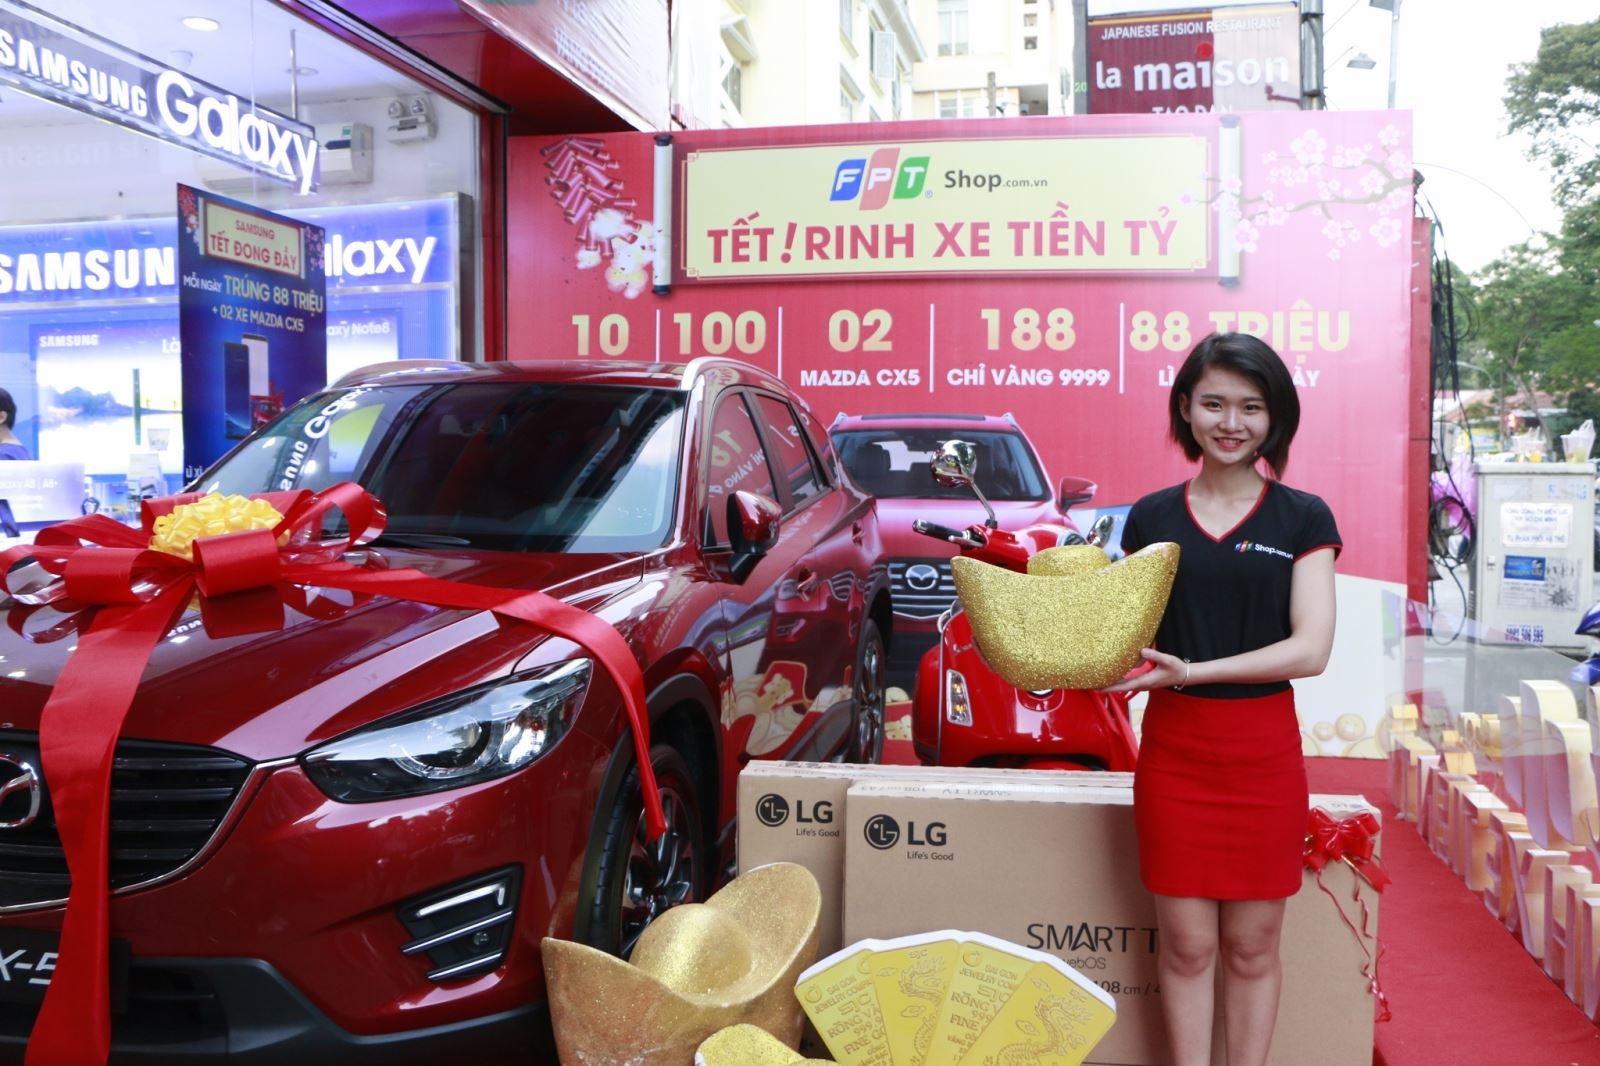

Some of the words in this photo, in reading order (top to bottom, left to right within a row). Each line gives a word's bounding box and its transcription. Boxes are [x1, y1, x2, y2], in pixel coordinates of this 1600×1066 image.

[1101, 25, 1159, 40] JAPANESE
[1162, 22, 1204, 36] FUSION
[1206, 16, 1282, 34] RESTAURANT
[1096, 60, 1122, 90] la
[1133, 50, 1289, 92] maison
[0, 29, 148, 118] SAMSUNG
[156, 70, 318, 196] Galaxy
[832, 162, 928, 196] FPT
[210, 230, 230, 254] TẾT
[234, 219, 276, 240] SAMSUNG
[805, 222, 914, 260] RINH
[932, 222, 990, 258] XE
[1007, 200, 1106, 257] TIỀN
[1123, 205, 1178, 256] TỶ
[0, 246, 176, 294] SAMSUN
[325, 234, 438, 284] laxy
[224, 273, 271, 302] TRÚNG
[273, 286, 290, 306] 88
[292, 288, 324, 318] TRIỆU
[220, 303, 233, 319] 02
[235, 307, 249, 323] XE
[251, 310, 284, 329] MAZDA
[285, 317, 305, 333] CX5
[351, 321, 391, 335] Note8
[673, 310, 767, 354] 100
[828, 309, 893, 352] 02
[980, 307, 1077, 351] 188
[1129, 310, 1193, 352] 88
[39, 334, 99, 348] SAMSUNG
[572, 313, 630, 356] 10
[800, 369, 871, 386] MAZDA
[875, 369, 921, 386] CX5
[946, 363, 985, 386] CHỈ
[990, 363, 1054, 386] VÀNG
[1058, 368, 1111, 386] 9999
[796, 799, 833, 824] LG
[796, 828, 817, 836] Life's
[818, 829, 840, 837] Good
[907, 821, 947, 847] LG
[907, 851, 929, 860] Life's
[931, 852, 954, 861] Good
[1026, 922, 1135, 953] SMART
[1141, 926, 1159, 954] T
[0, 948, 60, 985] X-5
[1123, 985, 1141, 995] cm
[949, 1012, 978, 1032] FINE
[842, 1036, 871, 1055] FINE
